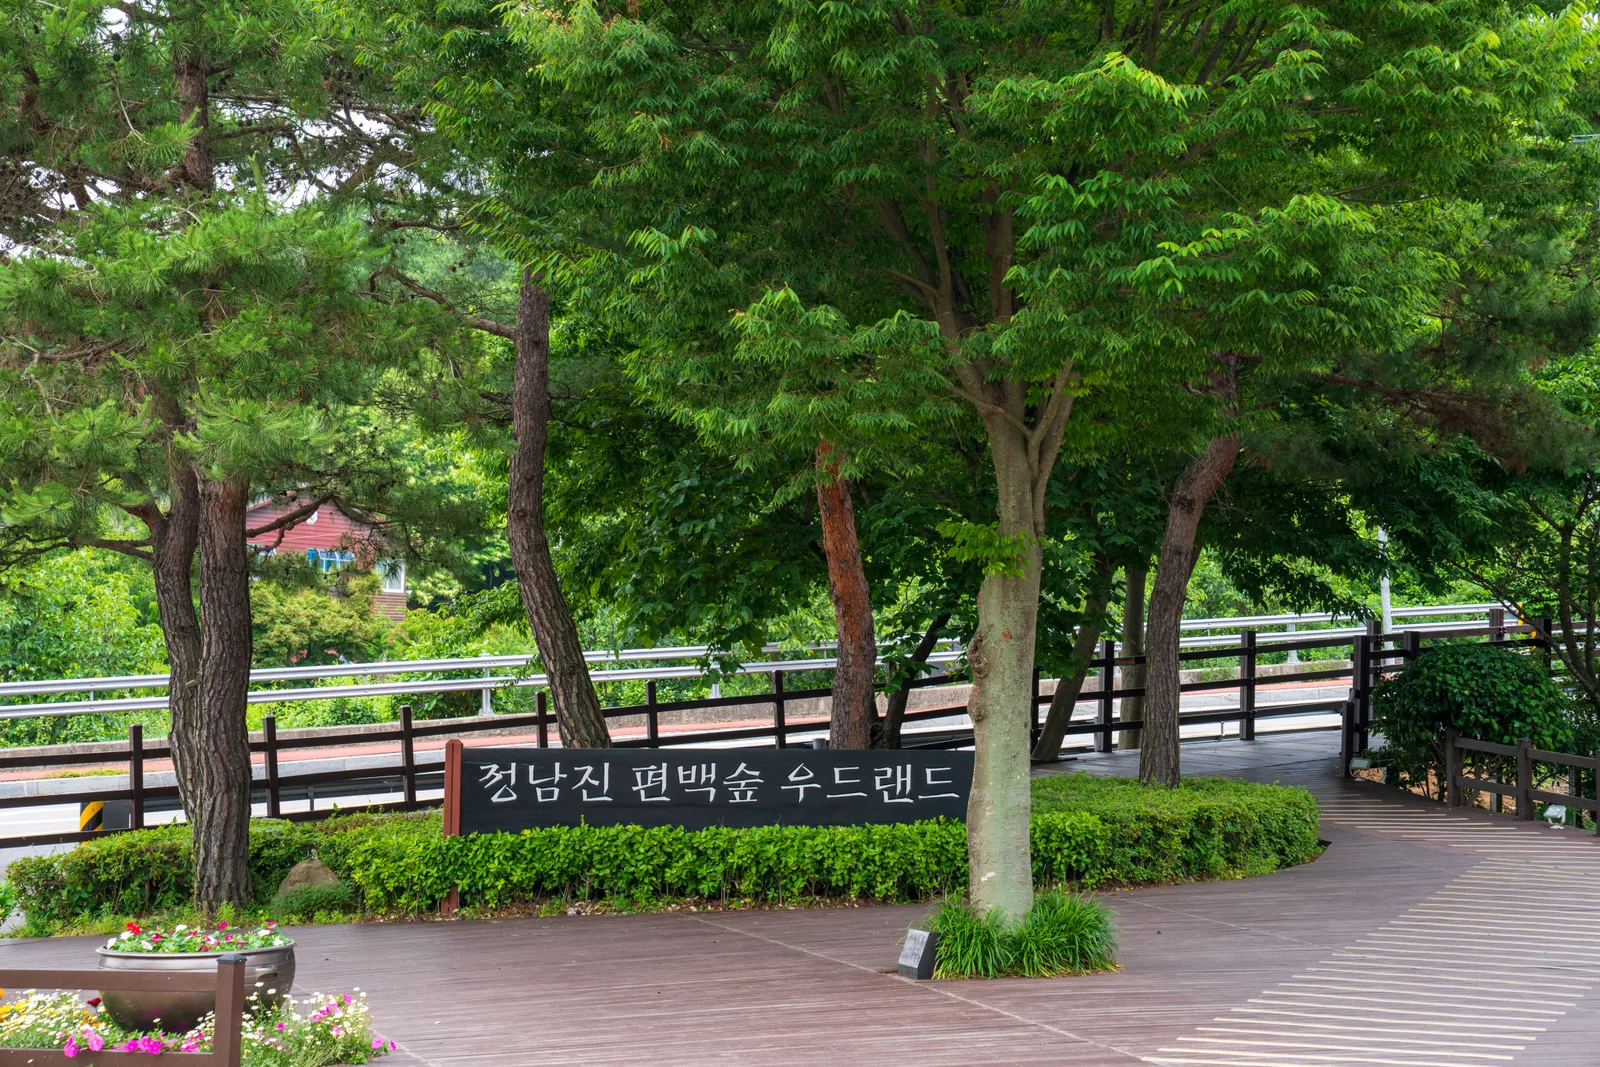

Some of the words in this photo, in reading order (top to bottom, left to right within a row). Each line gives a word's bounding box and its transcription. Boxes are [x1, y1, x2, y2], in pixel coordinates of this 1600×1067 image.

[479, 762, 613, 803] 정남진
[631, 761, 765, 803] 편백숲
[780, 762, 960, 804] 우드랜드
